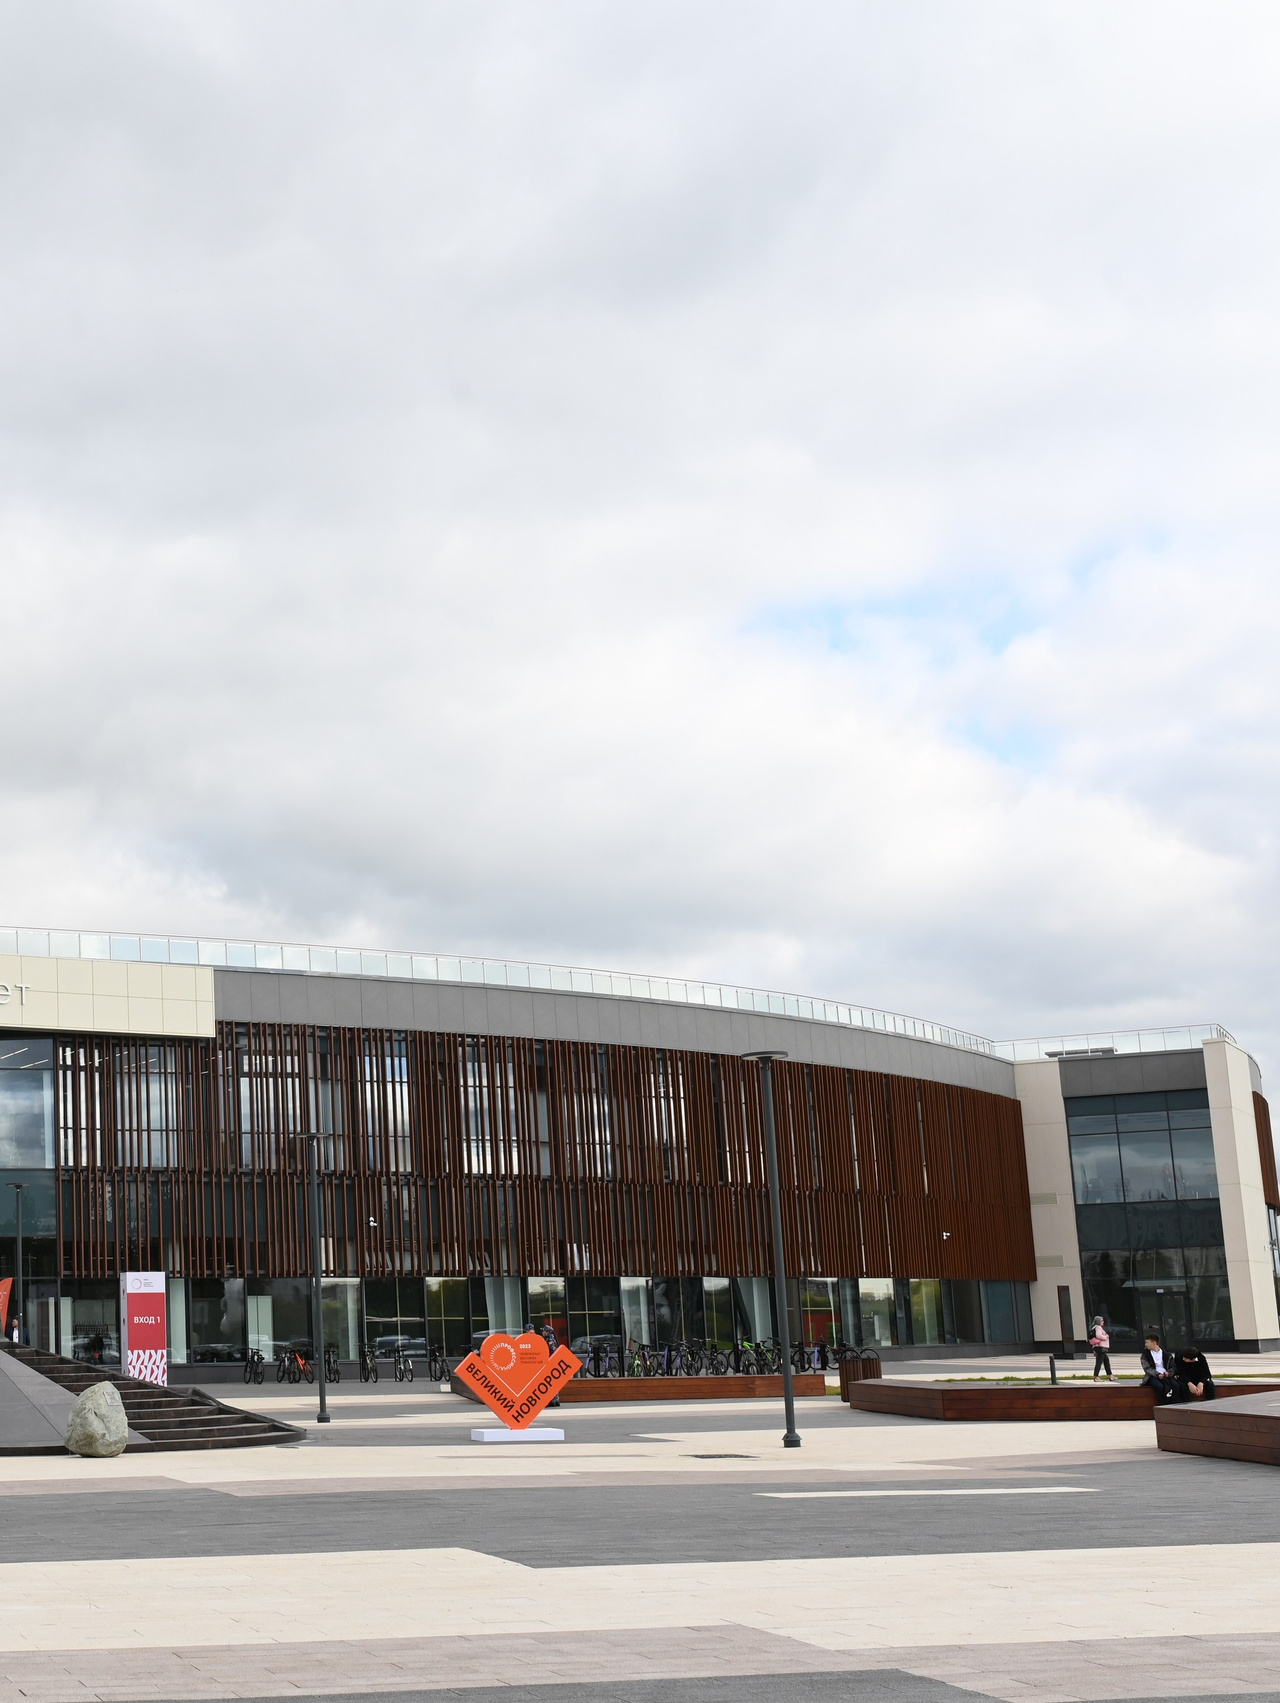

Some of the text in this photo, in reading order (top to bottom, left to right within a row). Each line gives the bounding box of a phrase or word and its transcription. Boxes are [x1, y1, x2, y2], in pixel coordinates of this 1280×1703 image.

[133, 1316, 155, 1325] ВХОД
[466, 1363, 516, 1412] ВЕЛИКИЙ
[512, 1359, 572, 1423] НОВГОРОД
